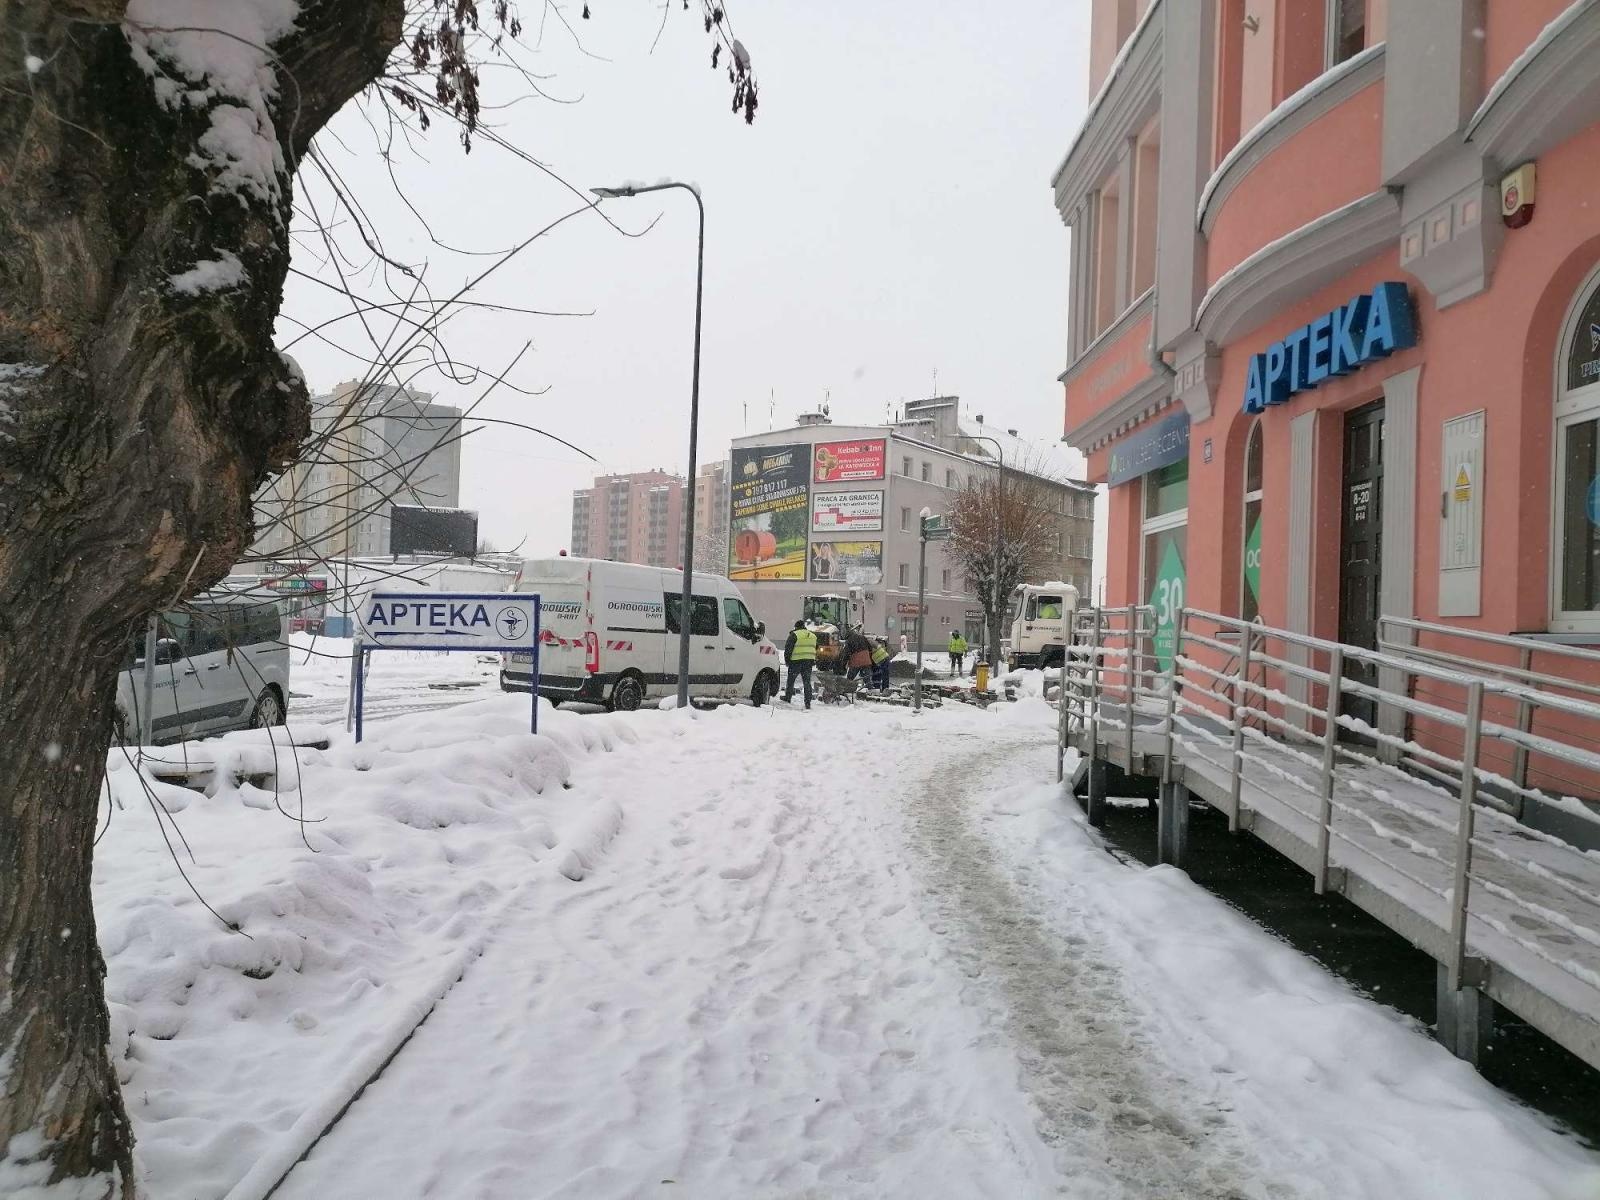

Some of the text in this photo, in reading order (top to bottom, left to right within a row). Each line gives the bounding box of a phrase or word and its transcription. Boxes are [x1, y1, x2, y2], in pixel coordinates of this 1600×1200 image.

[1243, 282, 1394, 413] APTEKA
[837, 446, 860, 454] Kebab
[1353, 490, 1369, 505] 8-20
[607, 601, 663, 613] OGRODOWSKI
[1158, 577, 1182, 625] 30
[367, 603, 491, 627] APTEKA
